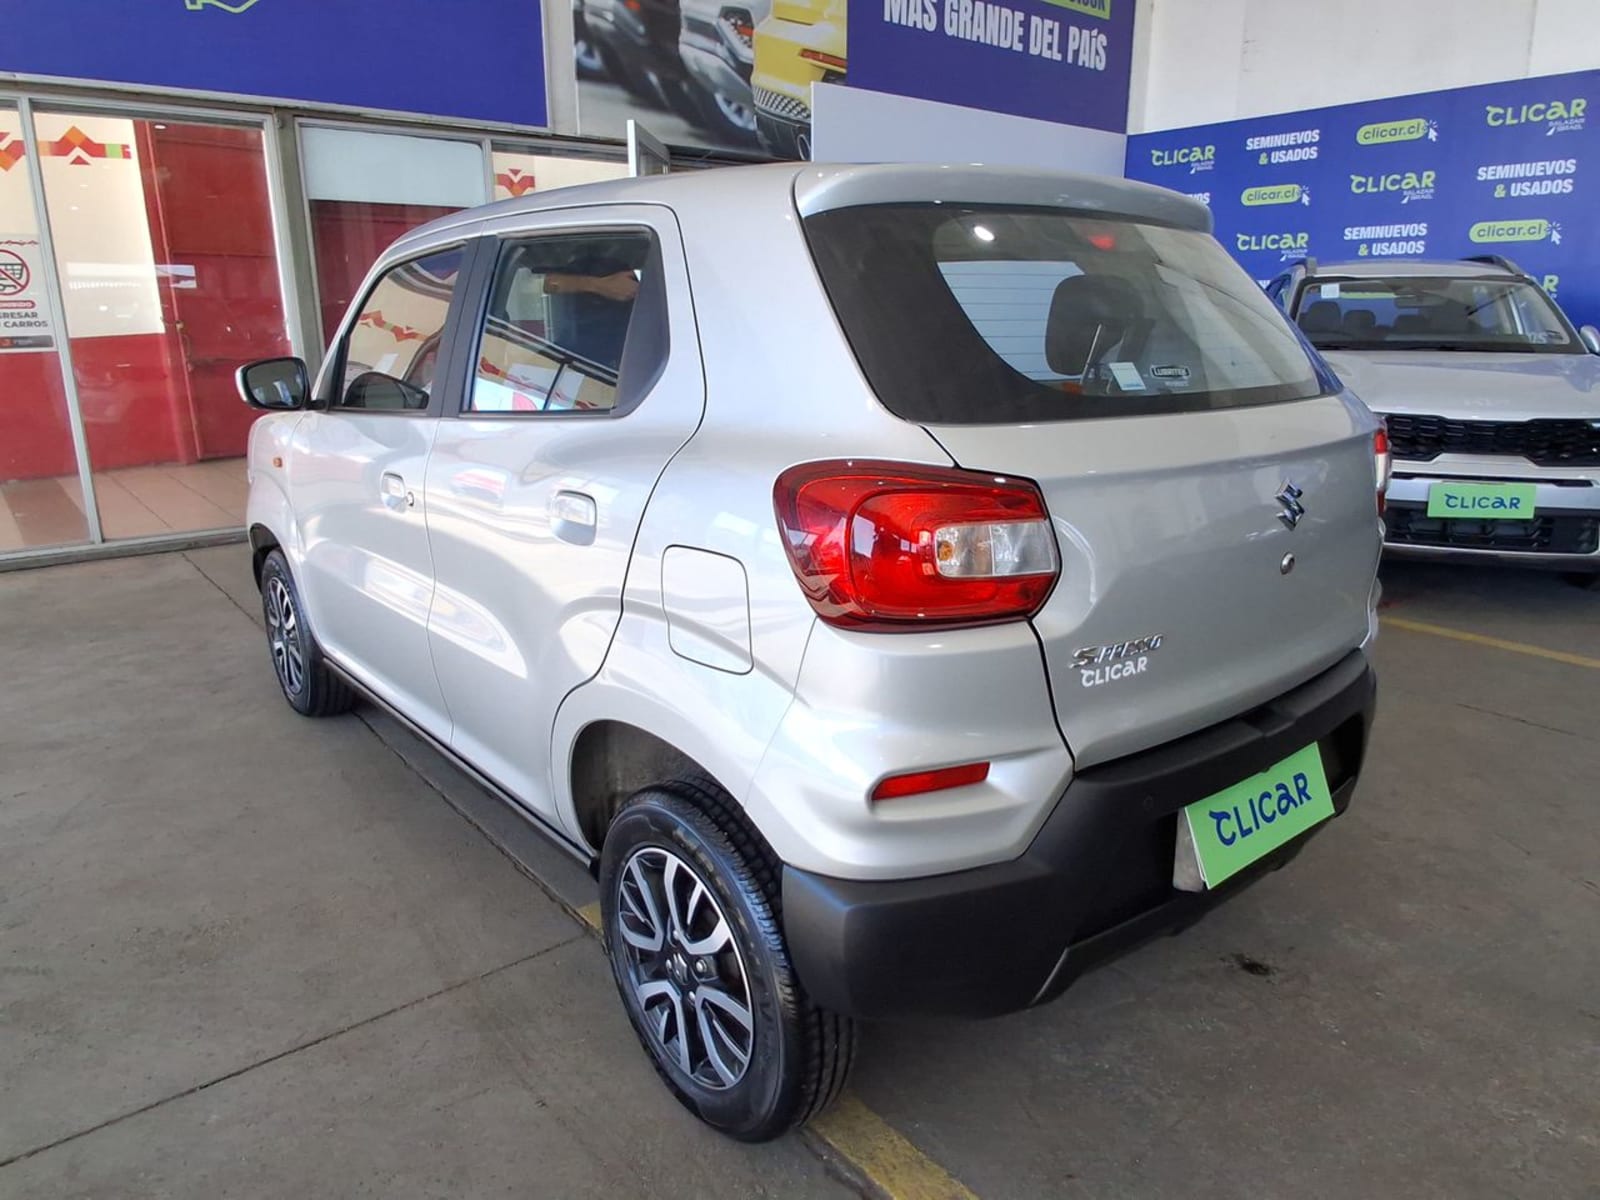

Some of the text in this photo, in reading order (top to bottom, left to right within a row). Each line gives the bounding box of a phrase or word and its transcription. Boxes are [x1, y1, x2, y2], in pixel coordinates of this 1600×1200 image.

[944, 0, 1024, 51] GRANDE
[1029, 15, 1062, 61] DEL
[1067, 25, 1107, 71] PAÍS
[1363, 123, 1420, 140] clicar.cl
[1246, 130, 1320, 151] SEMINUEVOS
[1258, 146, 1318, 165] & USADOS
[1477, 159, 1577, 181] SEMINUEVOS
[1247, 189, 1296, 202] clicar.cl
[1494, 178, 1574, 198] & USADOS
[1343, 223, 1428, 240] SEMINUEVOS
[1477, 223, 1542, 238] clicar.cl
[1358, 240, 1425, 256] & USADOS
[3, 320, 48, 328] CARROS
